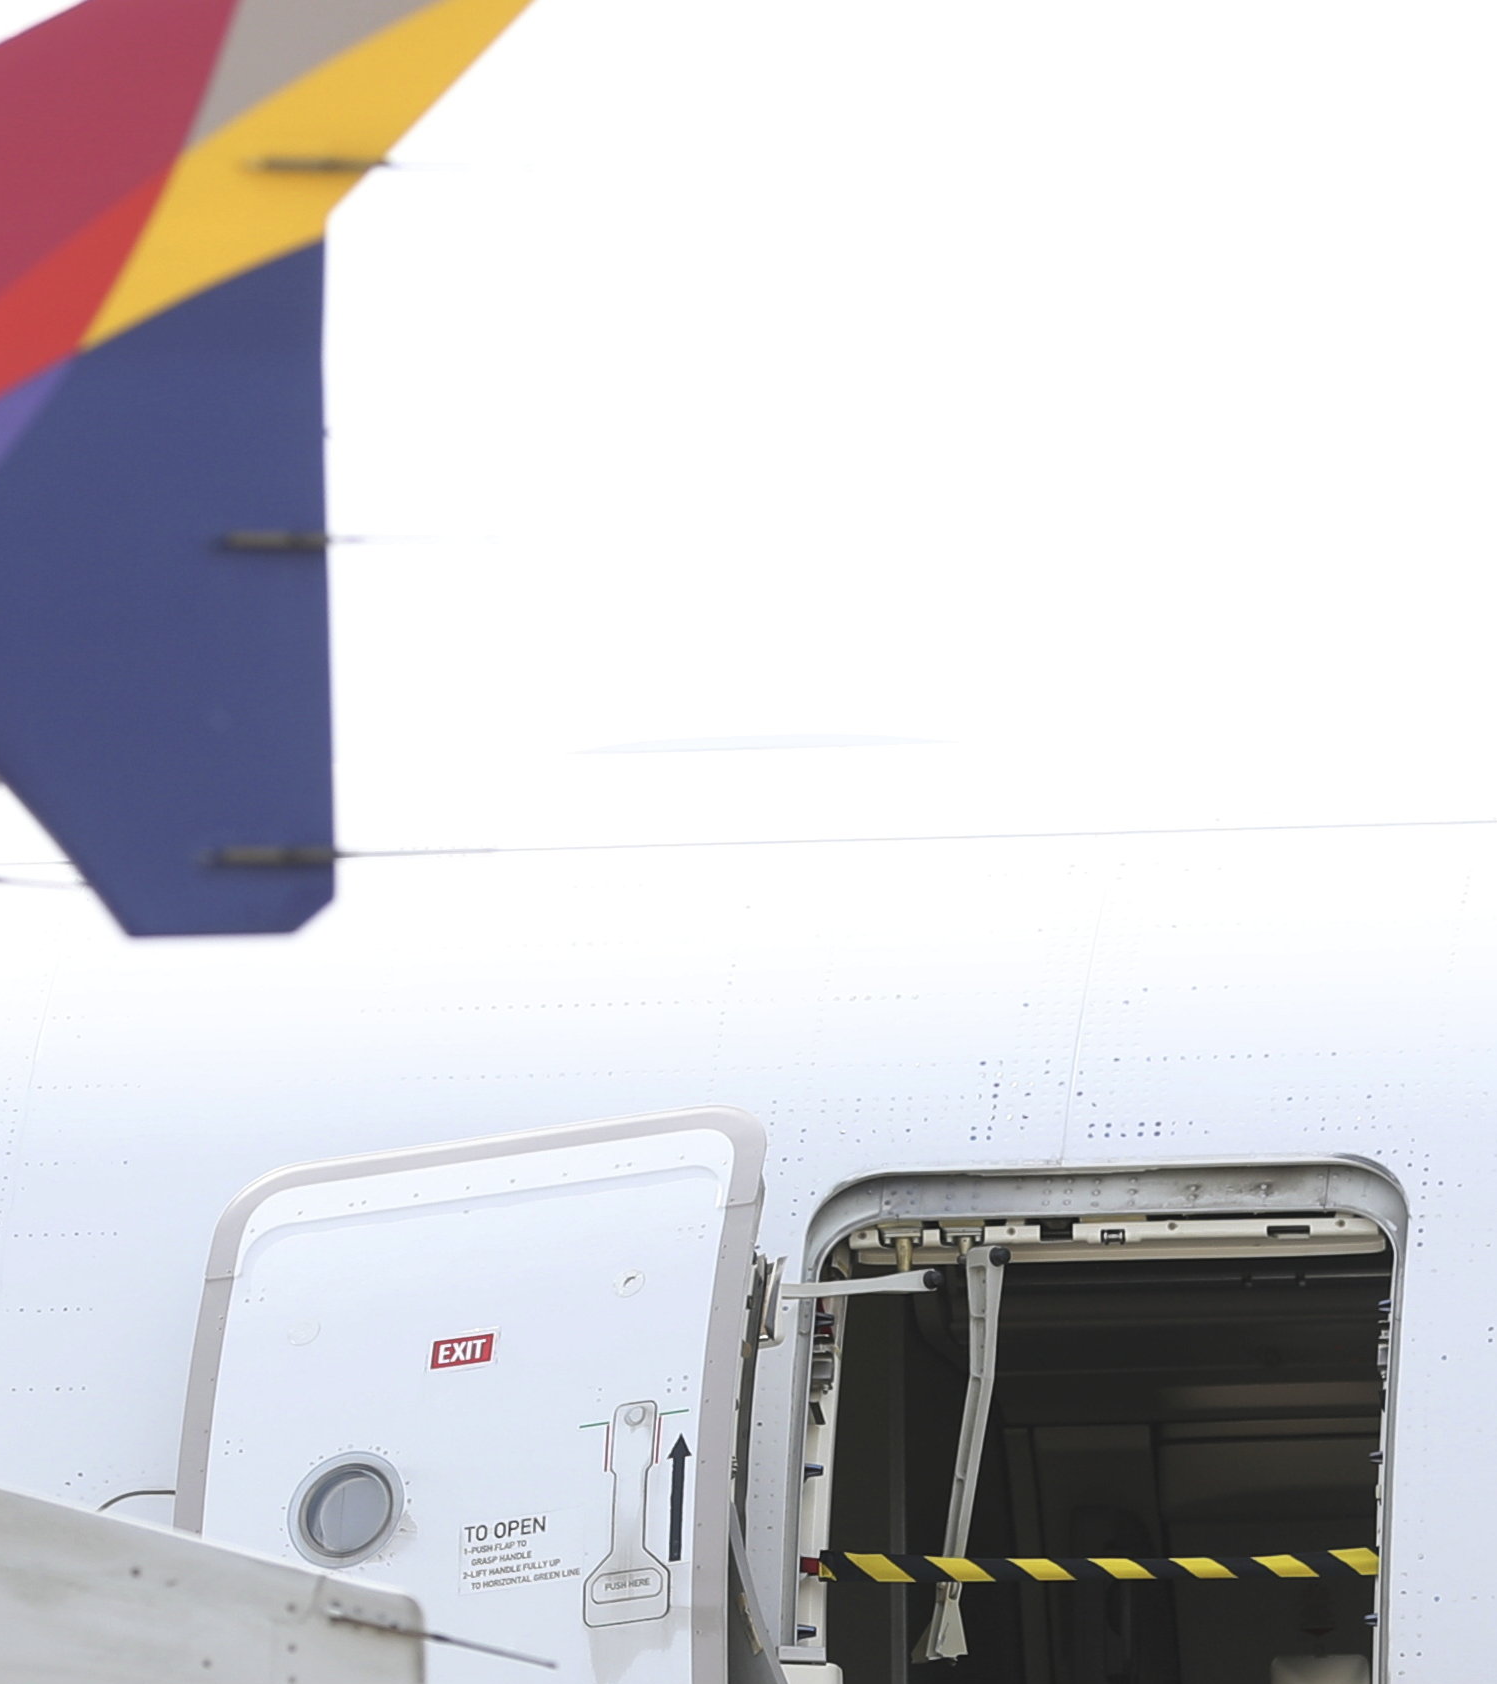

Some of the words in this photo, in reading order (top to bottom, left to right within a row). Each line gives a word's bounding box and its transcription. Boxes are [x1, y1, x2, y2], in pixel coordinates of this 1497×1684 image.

[438, 1338, 487, 1365] EXIT
[464, 1524, 488, 1543] TO
[493, 1515, 547, 1539] OPEN
[494, 1541, 516, 1552] FLAP
[517, 1539, 527, 1548] TO
[471, 1555, 498, 1567] GRASP
[499, 1550, 533, 1562] HANDLE
[488, 1563, 522, 1577] HANDLE
[522, 1560, 548, 1571] FULLY
[549, 1558, 561, 1568] UP
[471, 1581, 481, 1590] TO
[482, 1575, 531, 1589] HORIZONTAL
[533, 1570, 561, 1582] GREEN
[562, 1567, 581, 1578] LINE
[604, 1580, 627, 1592] PUSH
[628, 1577, 651, 1588] HERE
